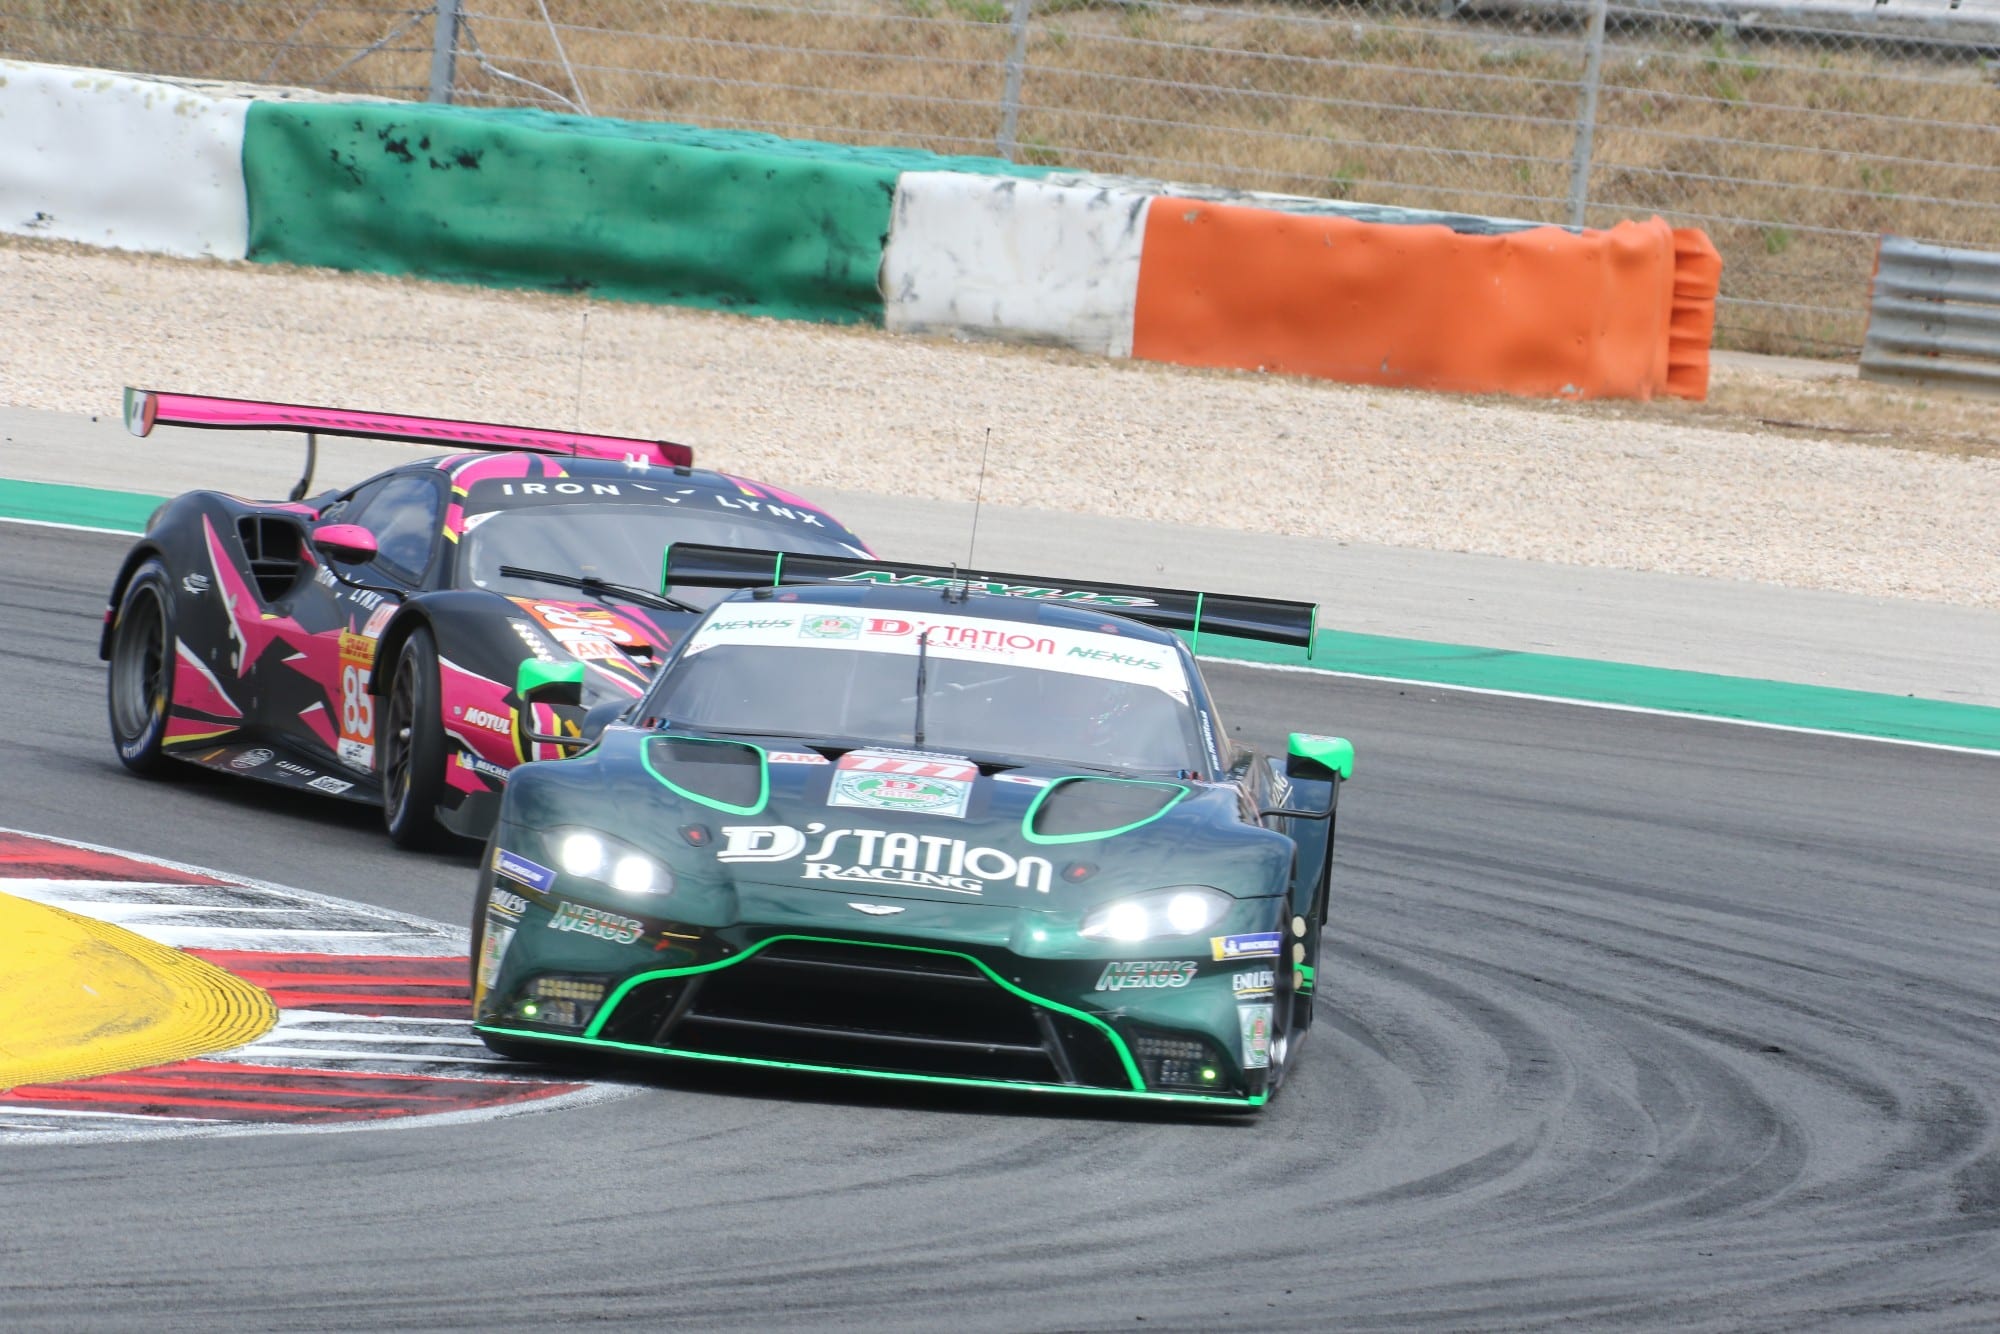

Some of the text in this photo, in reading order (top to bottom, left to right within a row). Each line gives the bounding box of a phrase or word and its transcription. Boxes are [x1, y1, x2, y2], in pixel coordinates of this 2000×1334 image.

[502, 482, 825, 528] IRON LYNX
[704, 618, 796, 632] NEXUS
[865, 618, 1056, 655] D'STATION
[574, 642, 618, 657] AM
[1066, 646, 1161, 670] NEXUS
[343, 664, 374, 739] 85
[463, 707, 511, 735] MOTUL
[769, 752, 826, 764] AM
[850, 756, 972, 779] 777
[716, 822, 1054, 894] D'STATION
[800, 862, 984, 893] RACING
[547, 901, 645, 945] NEXUS
[1095, 961, 1198, 991] NEXUS
